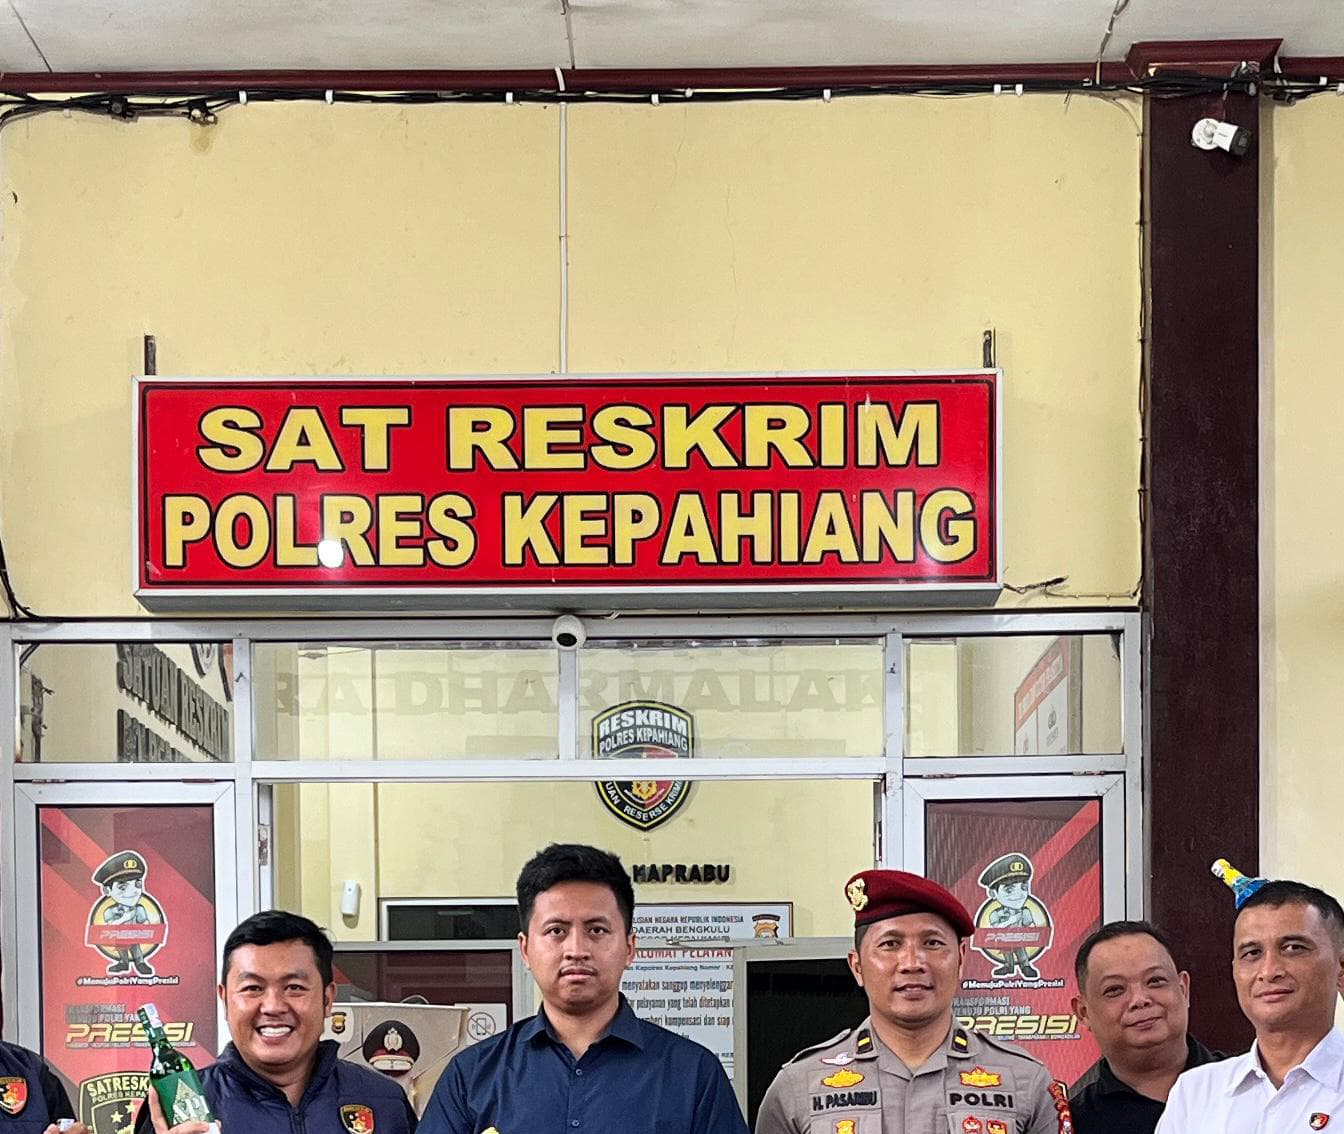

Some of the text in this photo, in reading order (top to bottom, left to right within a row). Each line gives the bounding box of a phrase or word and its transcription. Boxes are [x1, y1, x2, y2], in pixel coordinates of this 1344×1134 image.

[197, 402, 942, 472] SAT RESKRIM
[162, 488, 977, 567] POLRES KEPAHIANG
[599, 709, 687, 738] RESKRIM
[599, 727, 688, 754] POLRES KEPAHIANG
[623, 803, 668, 821] RESERSE
[632, 926, 731, 934] DAERAH BENGKULU
[983, 1006, 1008, 1014] POLRI
[1009, 1006, 1031, 1014] YANG
[65, 1022, 194, 1043] PRESSI
[954, 1015, 1078, 1036] PRESISI
[949, 1092, 1014, 1109] POLRI
